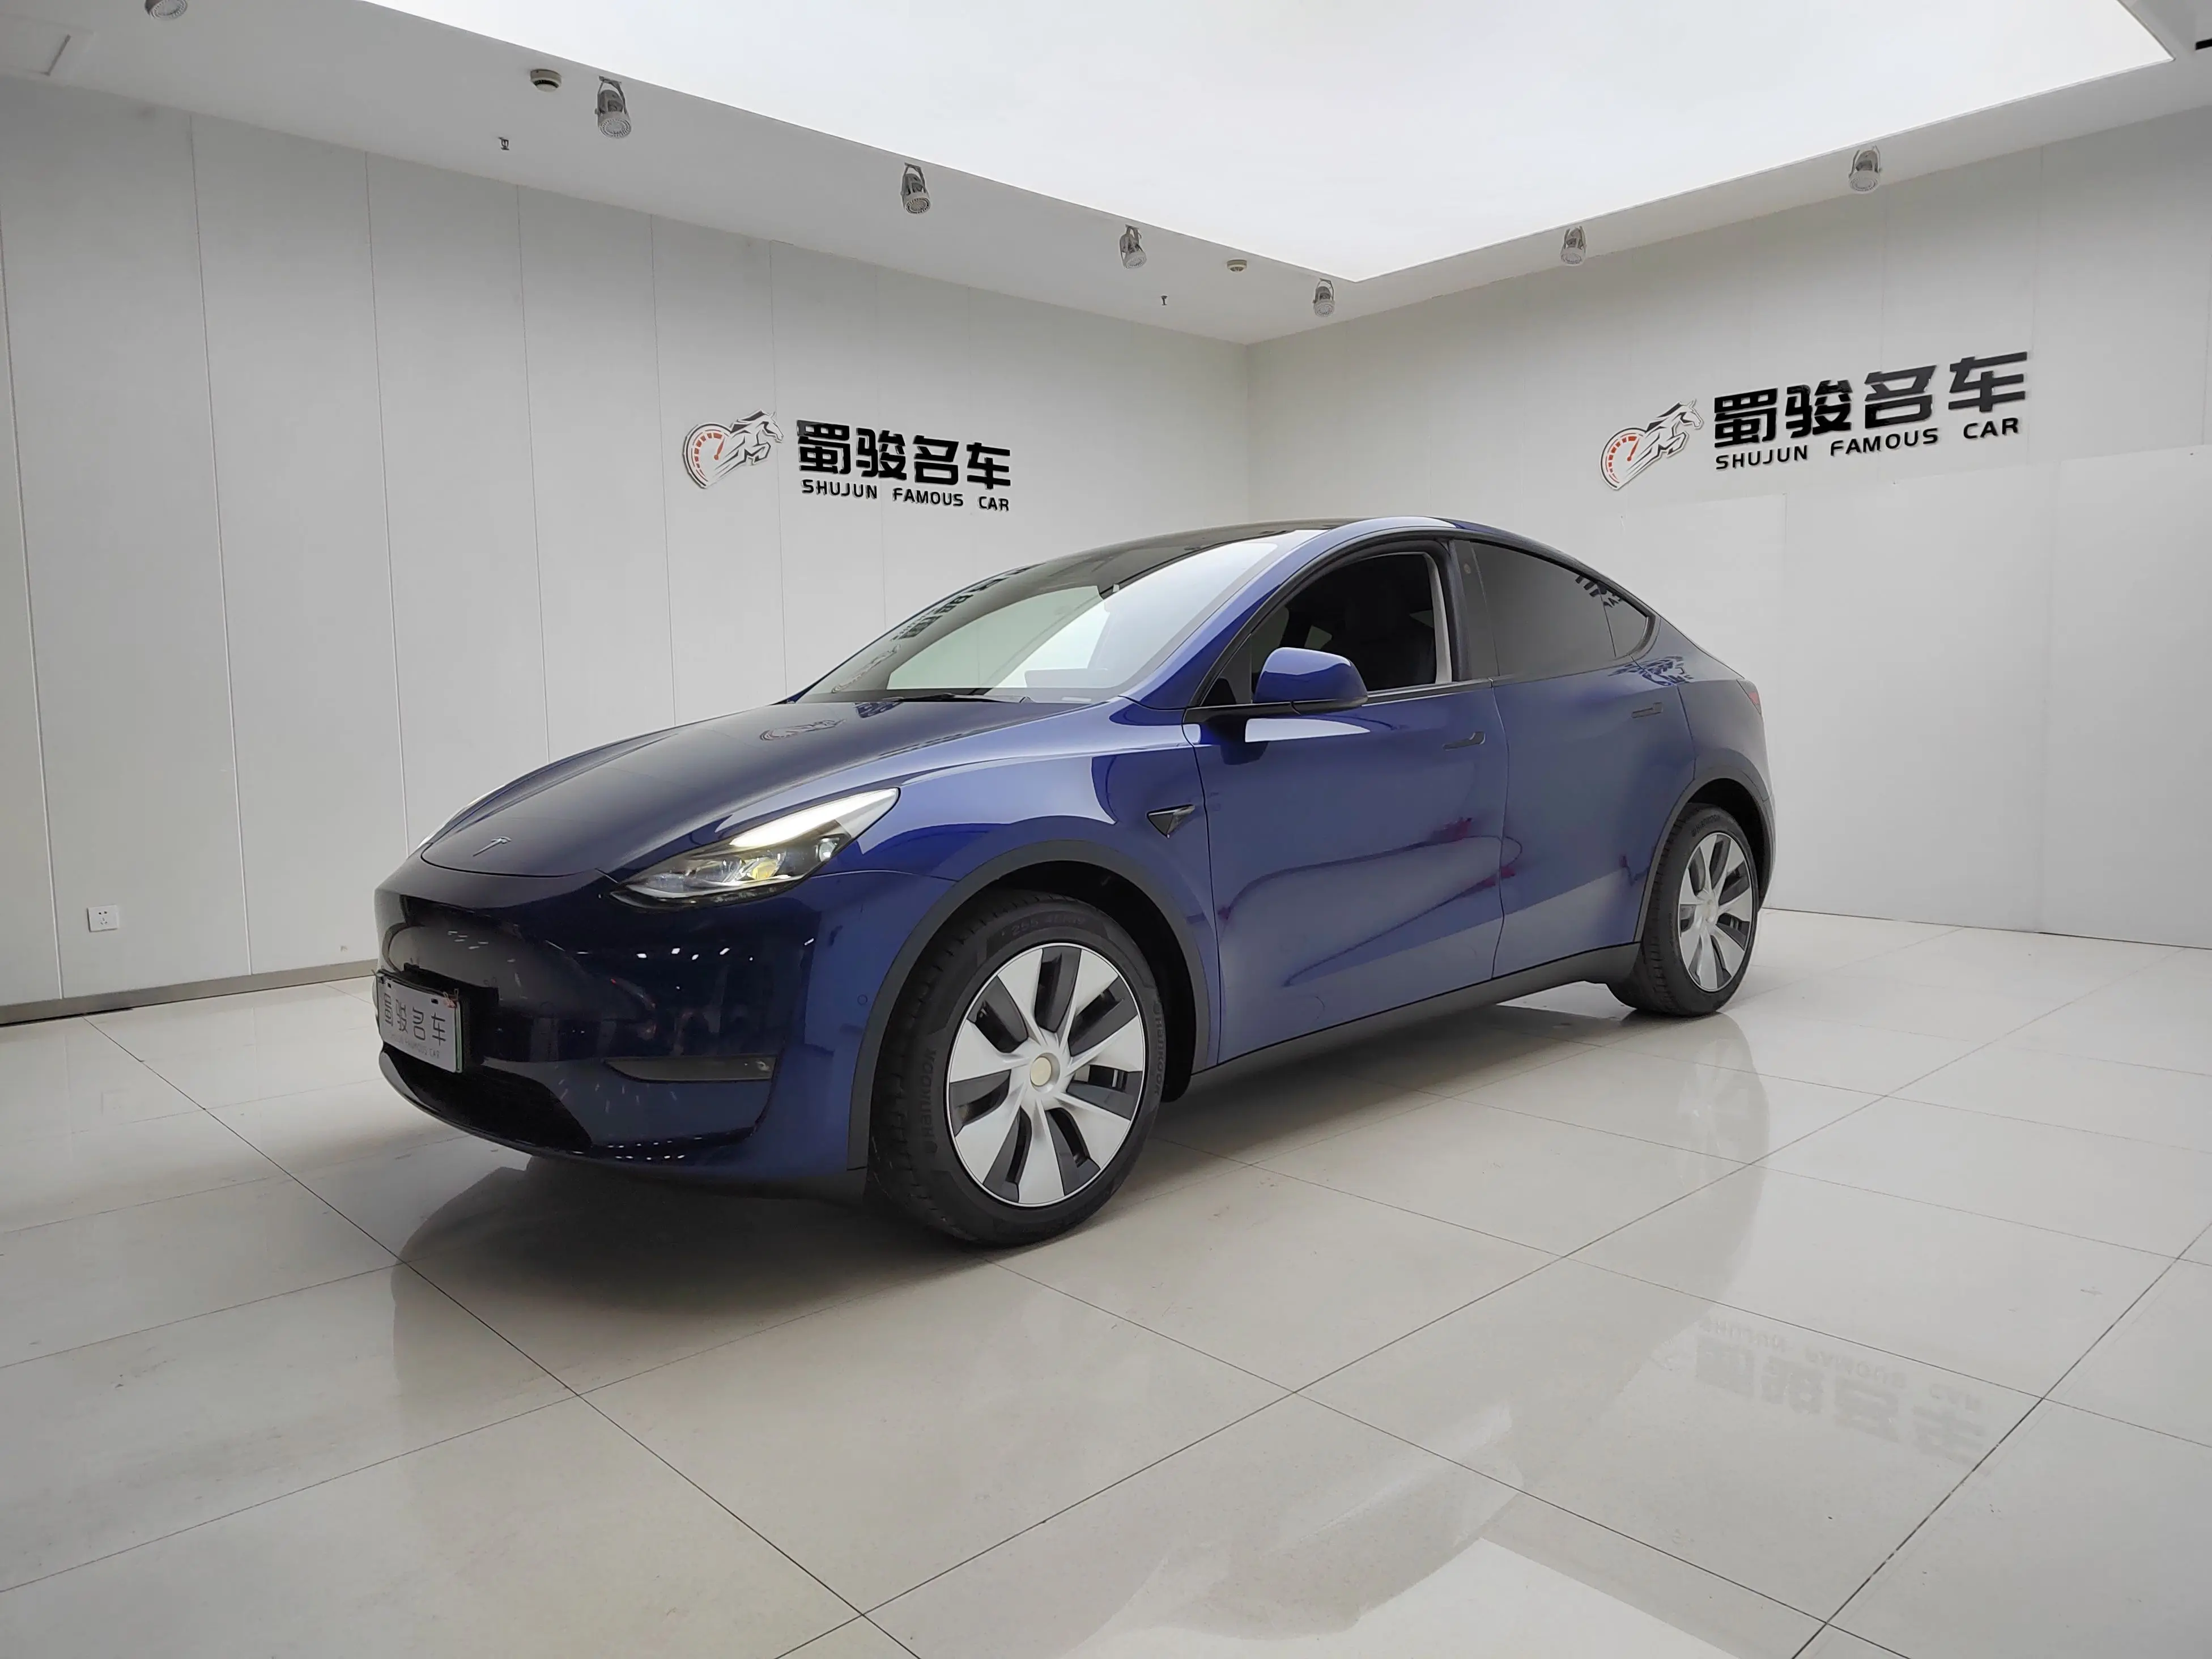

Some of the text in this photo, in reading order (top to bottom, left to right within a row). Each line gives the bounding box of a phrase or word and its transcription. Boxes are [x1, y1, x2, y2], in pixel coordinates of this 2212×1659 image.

[1713, 351, 2028, 449] 蜀骏名车
[796, 420, 1011, 490] 蜀骏名车
[1716, 417, 2019, 470] SHUJUN FAMOUS CAR
[802, 479, 1010, 511] SHUJUN FAMOUS CAR
[383, 992, 446, 1047] 蜀骏名车
